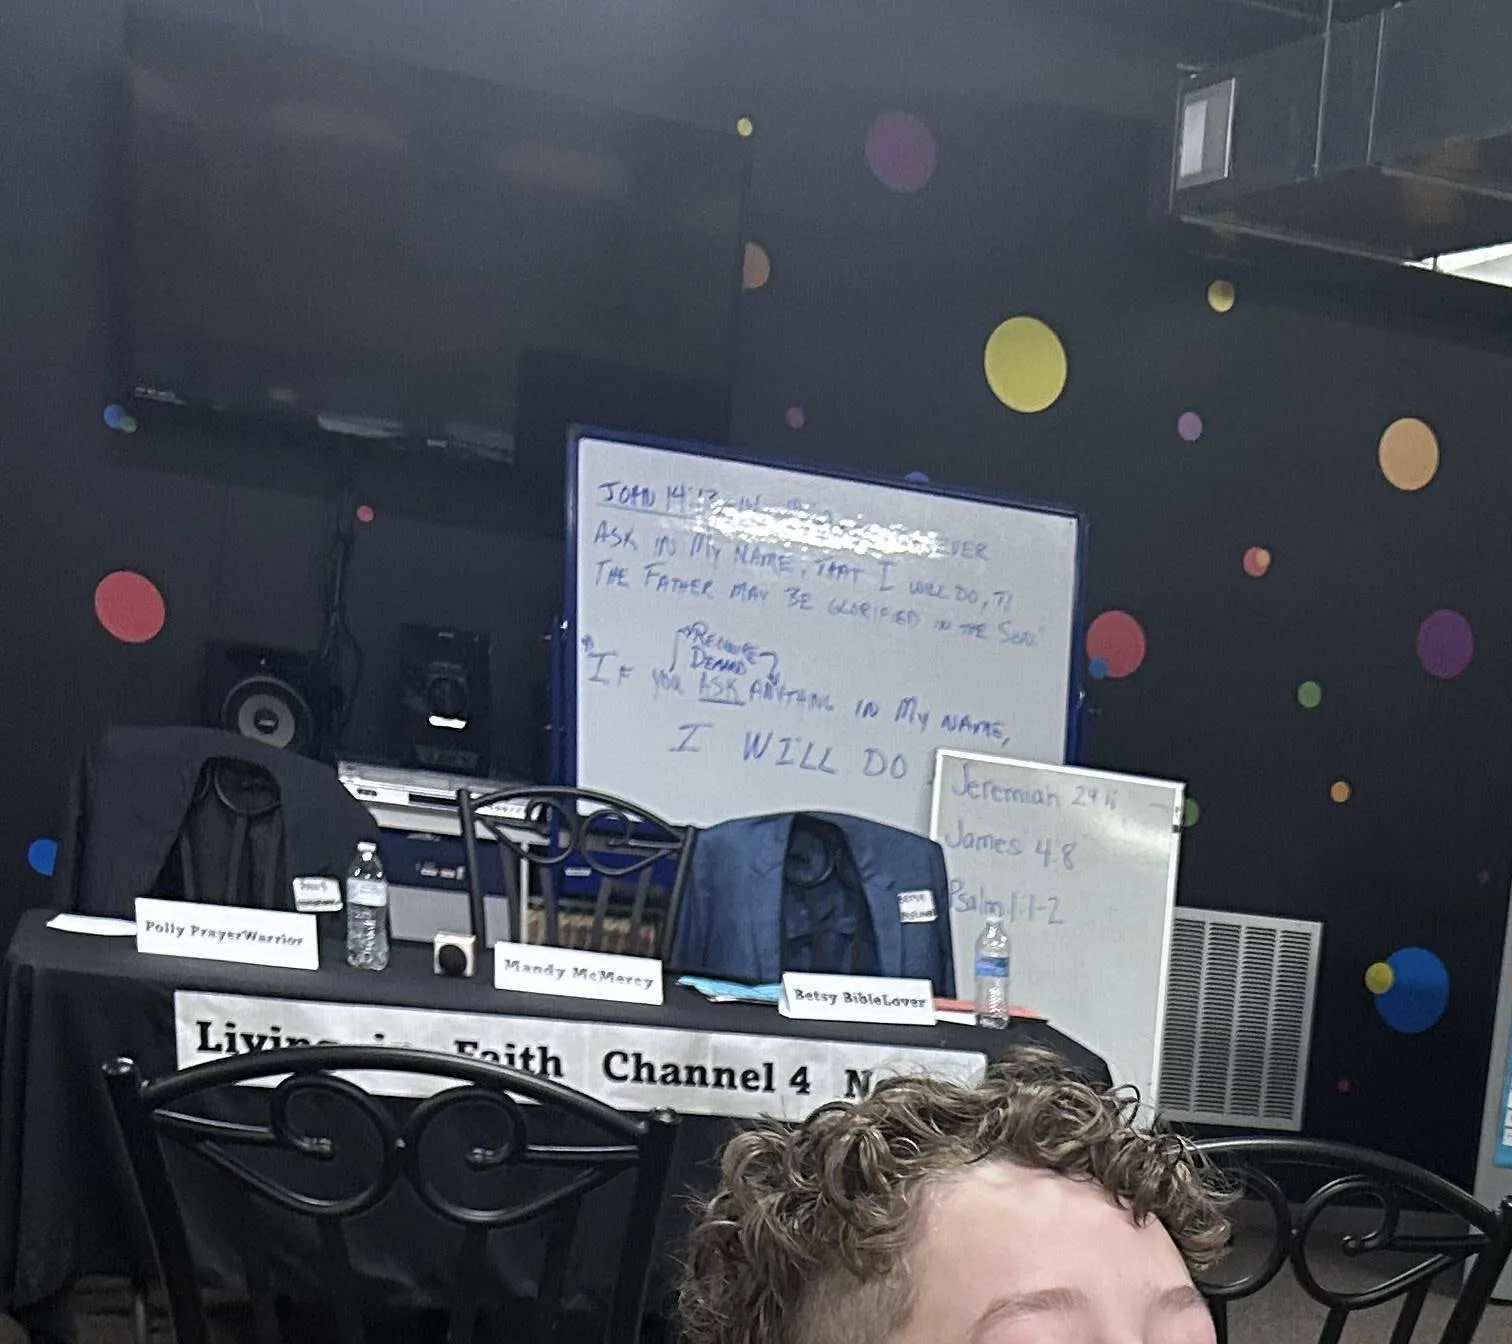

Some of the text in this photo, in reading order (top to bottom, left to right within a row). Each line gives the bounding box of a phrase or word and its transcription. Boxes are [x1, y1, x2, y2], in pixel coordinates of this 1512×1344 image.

[593, 520, 638, 551] ASK
[654, 535, 676, 557] IN
[878, 560, 896, 592] I
[596, 558, 630, 588] THE
[644, 561, 715, 599] FATHER
[730, 581, 770, 602] MAY
[784, 586, 813, 611] BE
[700, 671, 740, 700] ASK
[855, 698, 880, 719] IN
[668, 722, 909, 780] I WILL DO
[951, 763, 1061, 809] Jeremiah
[945, 820, 1022, 856] James
[144, 918, 304, 947] Polly PrayerWarrior
[504, 958, 654, 990] Mandy McMercy
[793, 988, 927, 1008] Betsy BibleLover
[195, 1019, 338, 1055] Livin
[602, 1049, 776, 1093] Channel
[788, 1064, 811, 1097] 4
